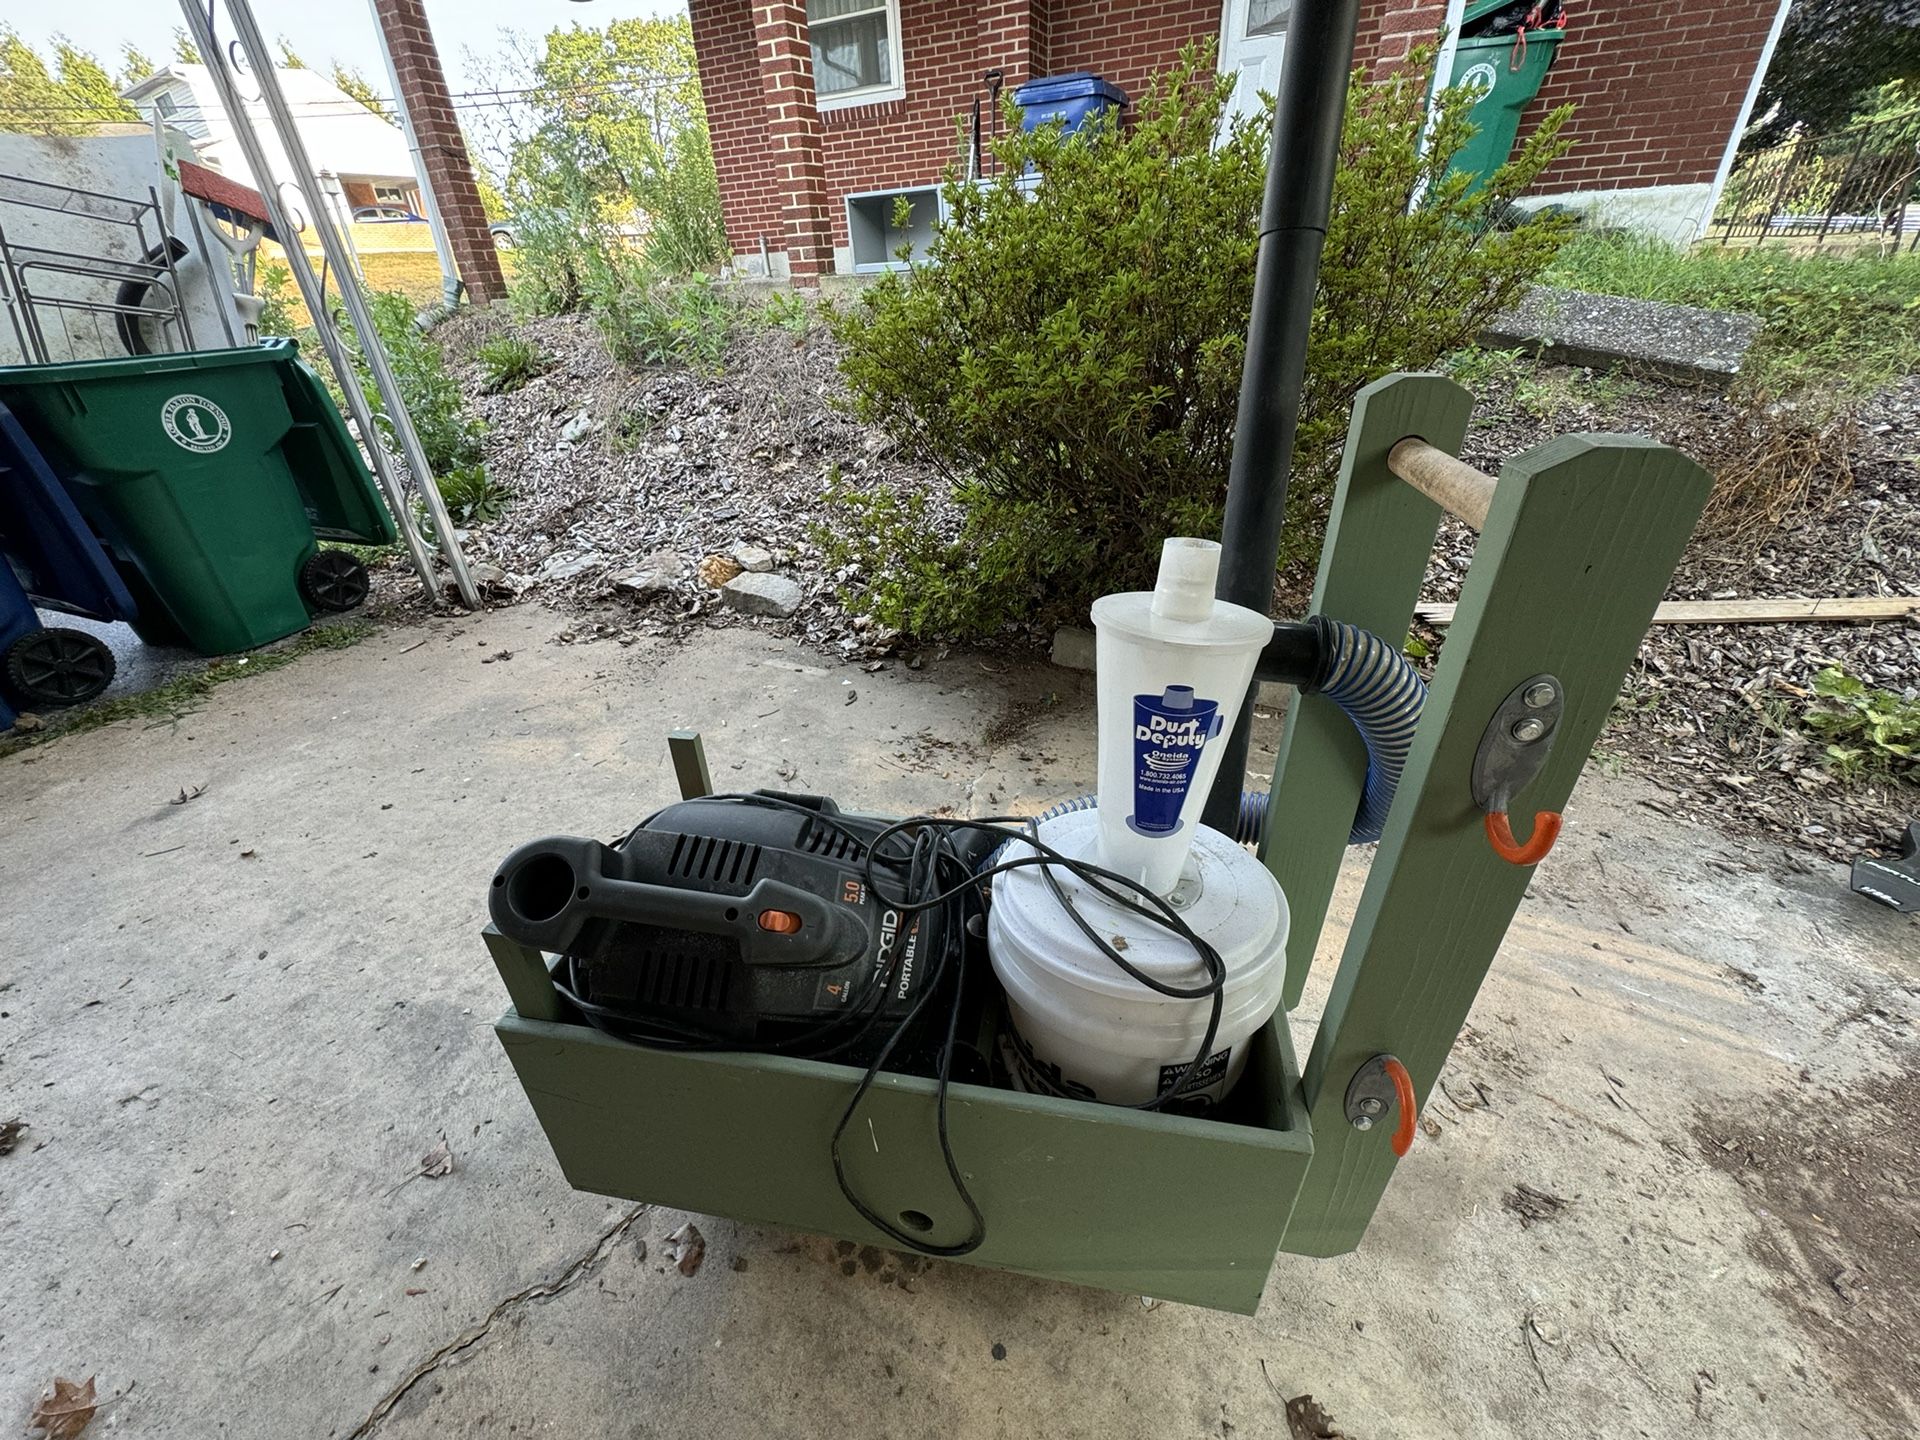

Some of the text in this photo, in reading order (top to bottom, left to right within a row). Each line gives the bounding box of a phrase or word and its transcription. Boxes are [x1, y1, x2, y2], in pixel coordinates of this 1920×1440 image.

[1150, 715, 1200, 733] Dust
[1136, 725, 1206, 749] Deputy
[1152, 750, 1189, 759] Oneida
[1138, 783, 1154, 792] Made
[843, 880, 860, 904] 5.0
[897, 934, 917, 1000] PORTABLE
[826, 984, 843, 996] 4
[1174, 1050, 1229, 1074] WNING
